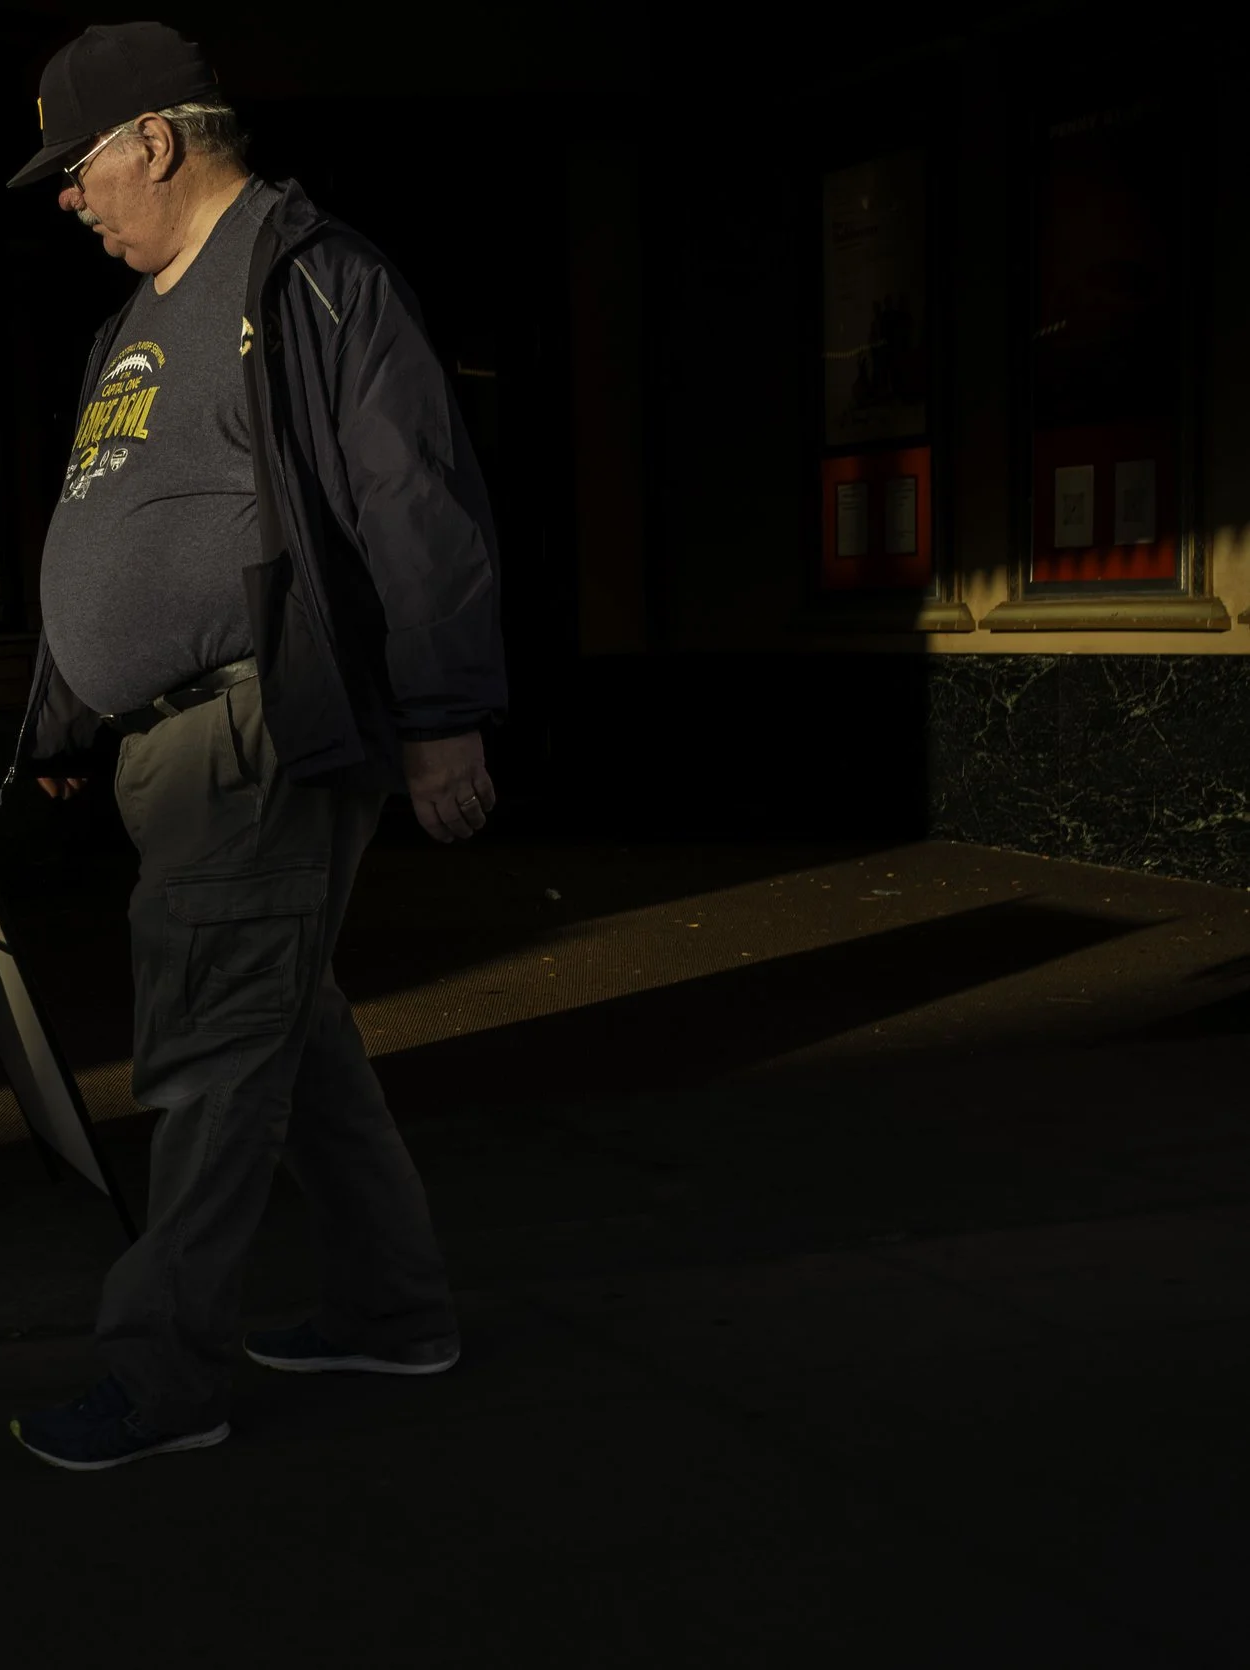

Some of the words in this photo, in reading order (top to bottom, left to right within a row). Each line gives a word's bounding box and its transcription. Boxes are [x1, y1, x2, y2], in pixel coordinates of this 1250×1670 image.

[102, 382, 125, 398] CAPITAL
[124, 376, 143, 392] ONE
[104, 386, 160, 440] BOWL
